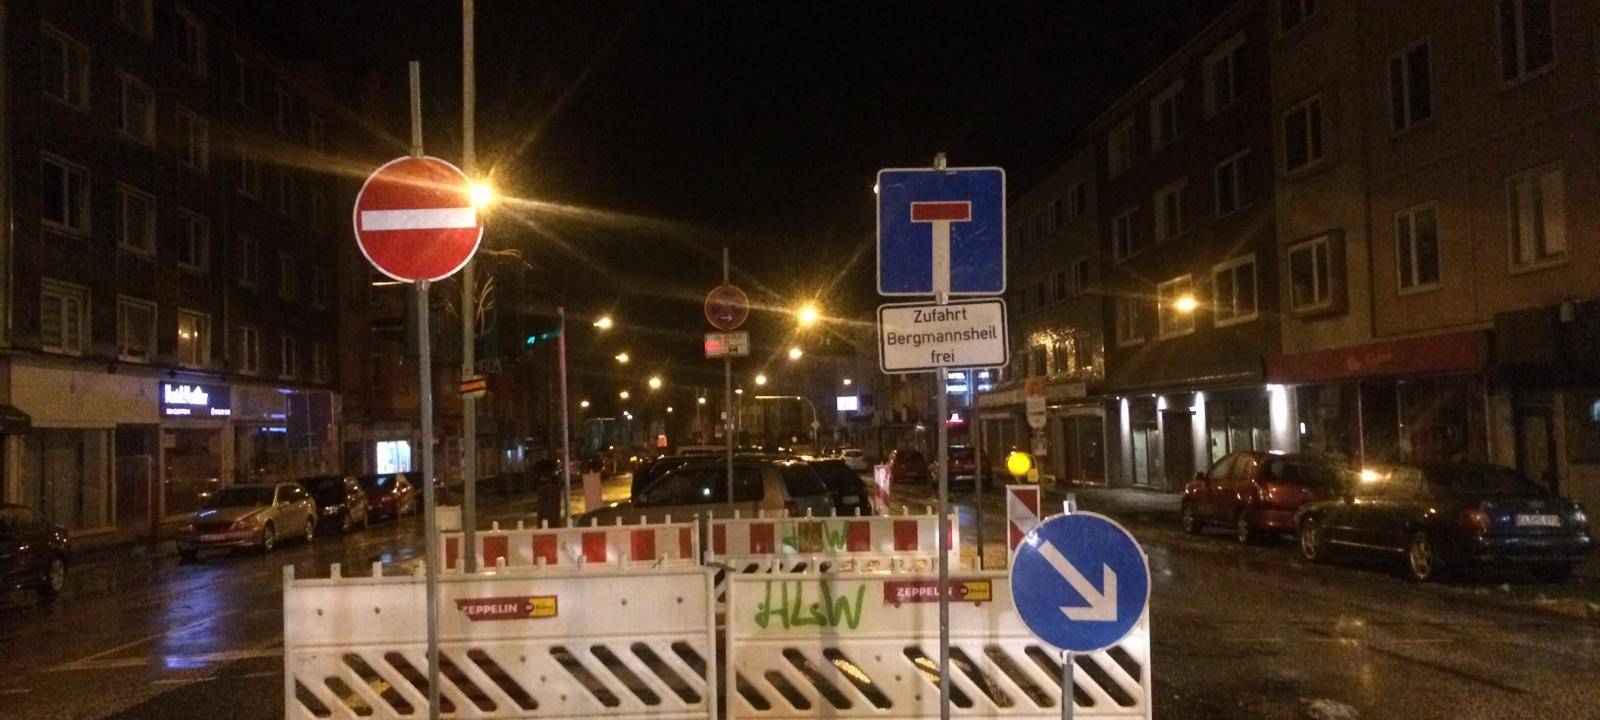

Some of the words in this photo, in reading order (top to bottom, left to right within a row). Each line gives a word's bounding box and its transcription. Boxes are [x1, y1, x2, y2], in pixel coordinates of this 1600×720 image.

[913, 308, 967, 323] Zufahrt
[887, 325, 997, 347] Bergmannsheil
[931, 349, 955, 363] frei
[896, 586, 953, 597] ZEPPEL
